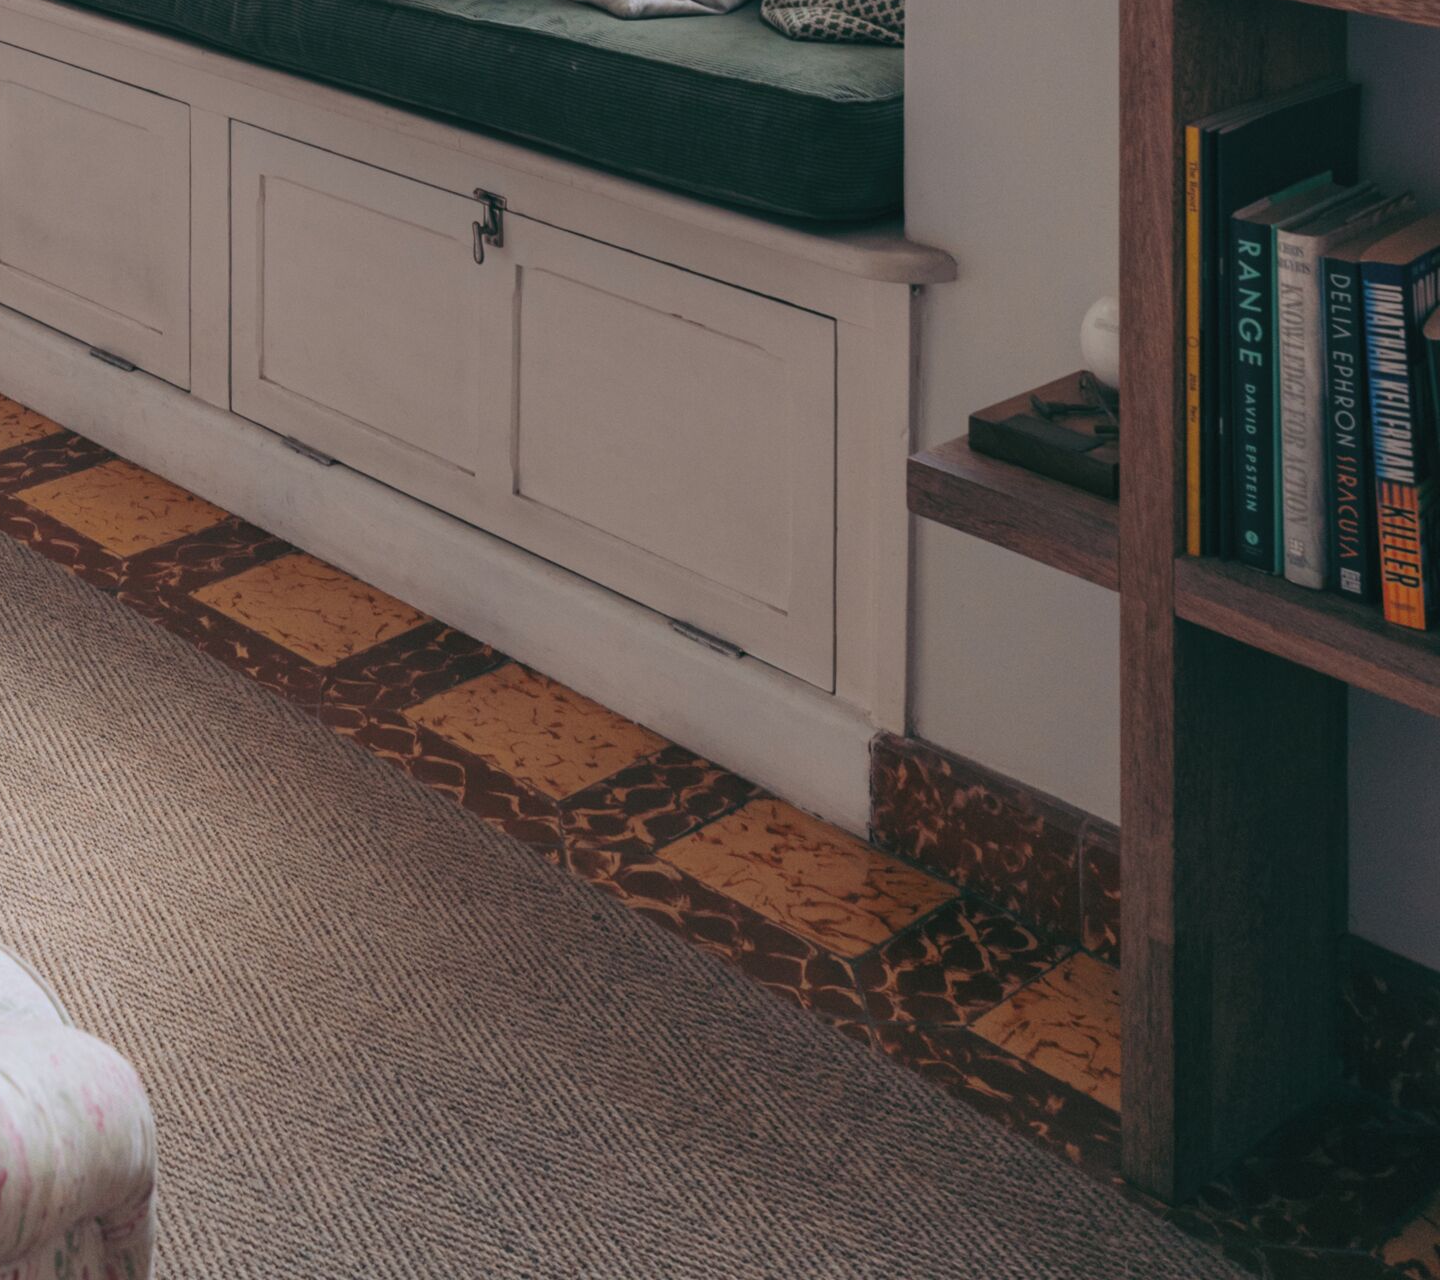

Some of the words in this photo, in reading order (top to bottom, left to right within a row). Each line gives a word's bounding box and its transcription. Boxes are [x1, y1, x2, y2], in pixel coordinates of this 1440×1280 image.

[1187, 181, 1198, 213] Report
[1189, 160, 1199, 180] The
[1238, 239, 1262, 367] RANGE
[1281, 282, 1306, 400] KNOWLEDGE
[1330, 273, 1352, 339] DELIA
[1363, 279, 1408, 376] JONATHAN
[1245, 384, 1257, 435] DAVID
[1283, 406, 1307, 448] FOR
[1332, 350, 1356, 448] EPHRON
[1370, 377, 1415, 484] KELLERMAN
[1246, 444, 1257, 513] EPSTEIN
[1284, 450, 1308, 527] ACTION
[1337, 455, 1359, 559] SIRACUSA
[1381, 504, 1420, 588] KILLER
